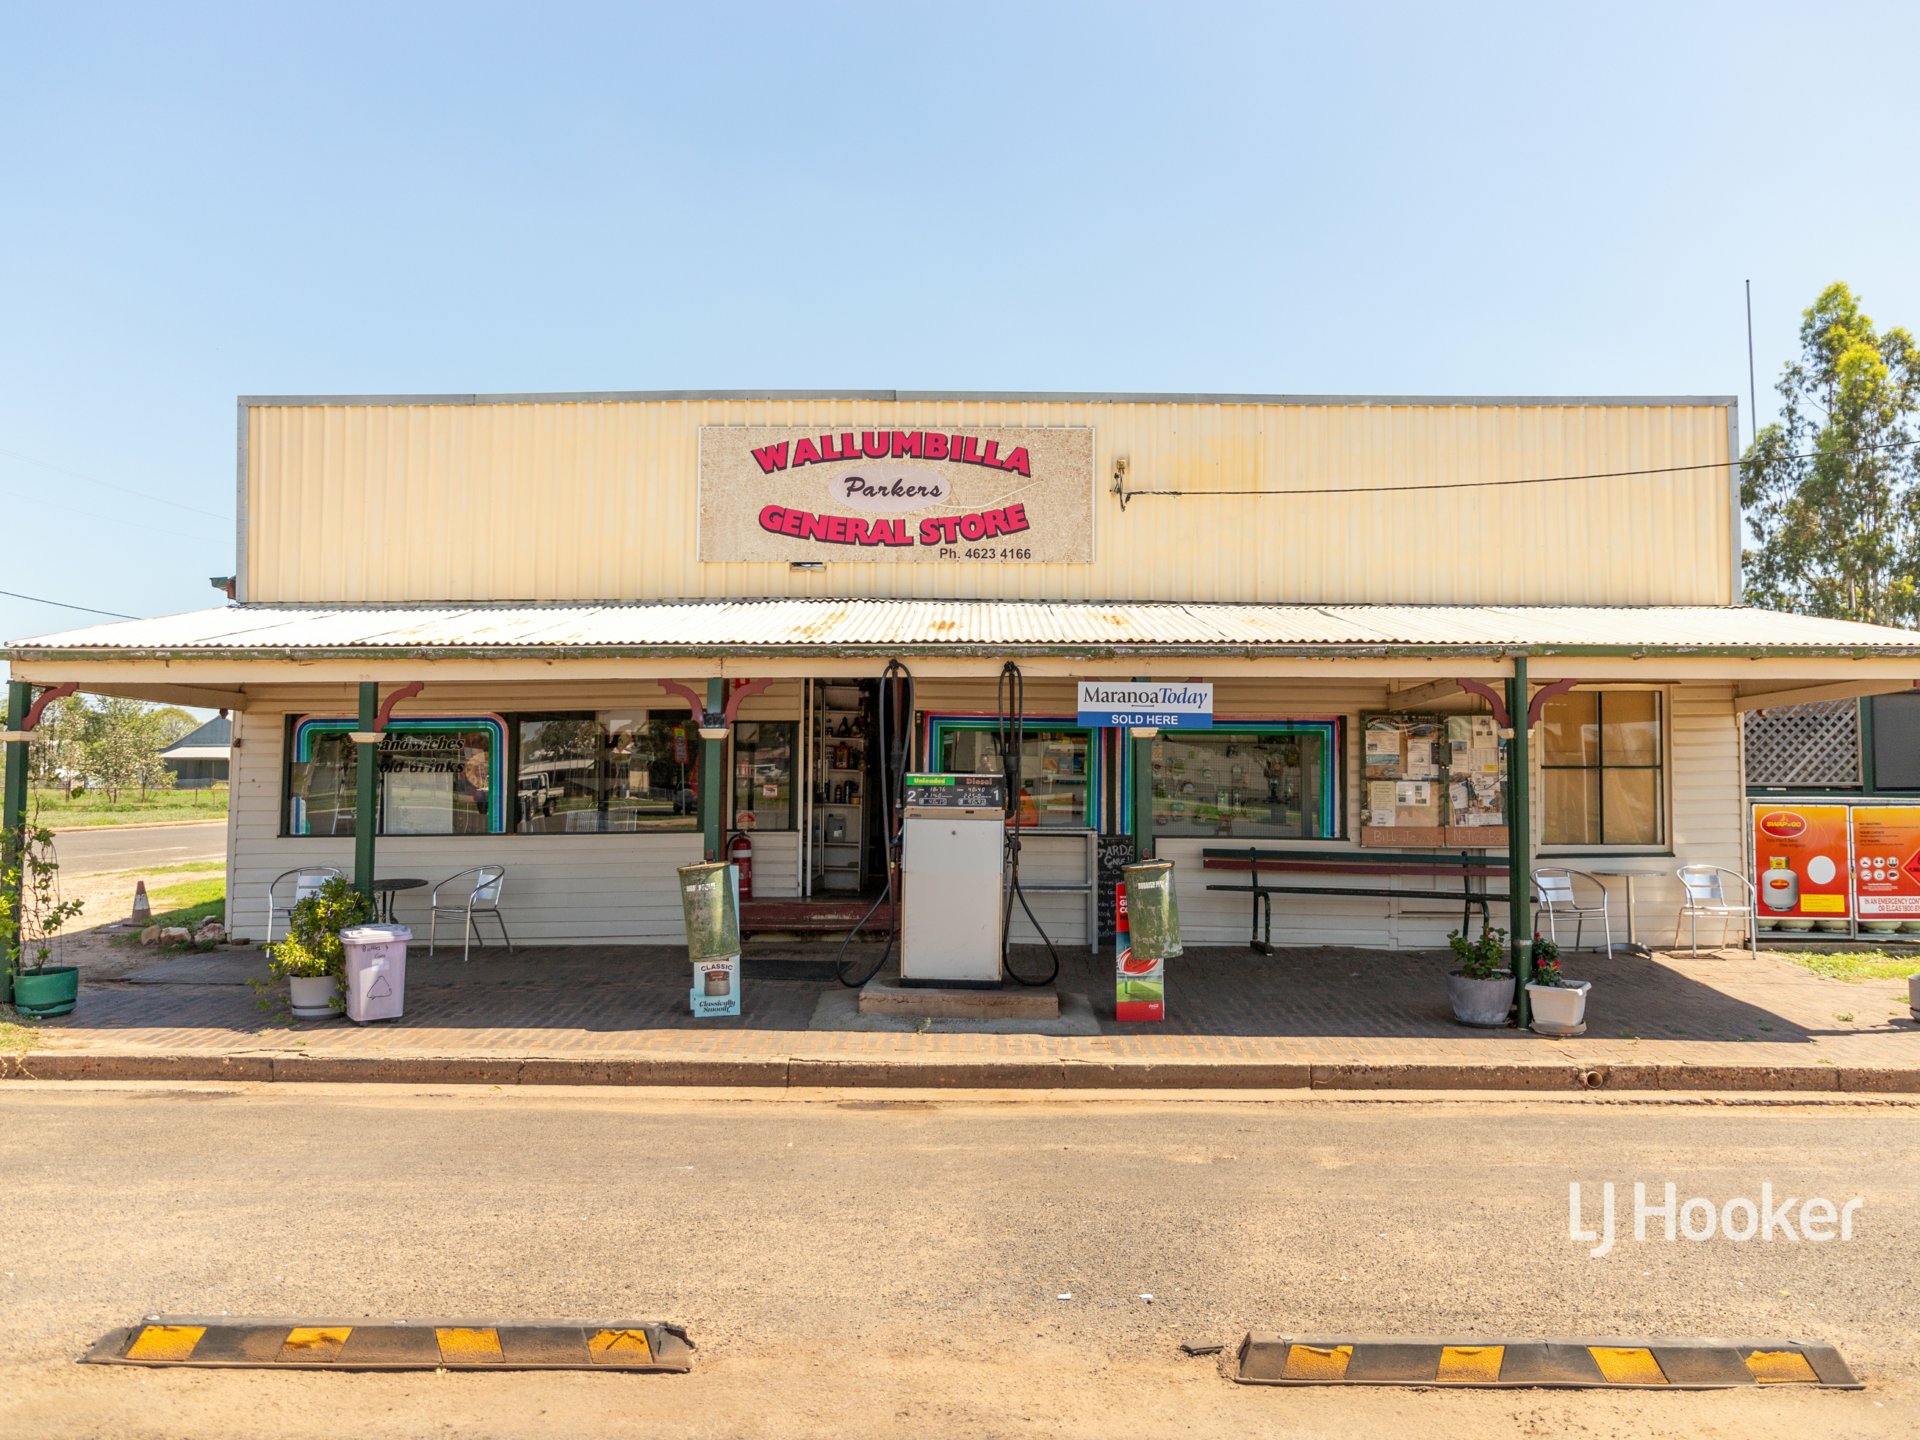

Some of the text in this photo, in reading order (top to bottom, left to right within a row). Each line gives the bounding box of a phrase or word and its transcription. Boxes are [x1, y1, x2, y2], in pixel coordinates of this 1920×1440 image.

[751, 431, 1031, 478] WALLUMBILLA
[844, 476, 943, 498] Parkers
[759, 503, 1030, 547] GENERAL STORE
[939, 548, 1032, 559] Ph. 4623 4166
[1111, 714, 1179, 725] SOLD HERE
[377, 735, 465, 751] andwiches
[409, 758, 465, 773] drinks
[966, 777, 993, 785] Diesel
[907, 790, 917, 802] 2
[993, 790, 999, 801] 1
[701, 963, 734, 971] CLASSIC
[699, 1000, 736, 1008] Classically
